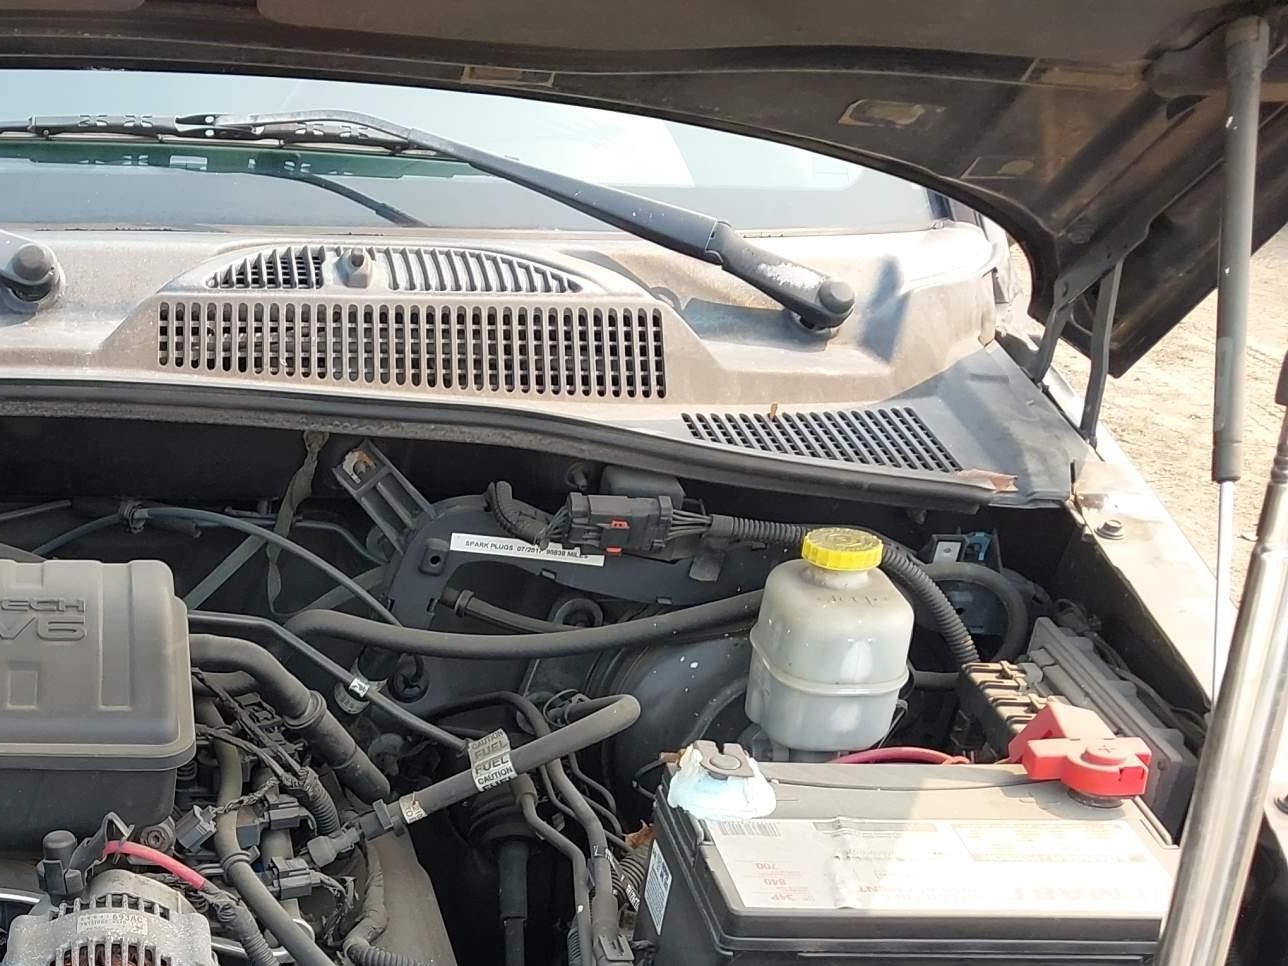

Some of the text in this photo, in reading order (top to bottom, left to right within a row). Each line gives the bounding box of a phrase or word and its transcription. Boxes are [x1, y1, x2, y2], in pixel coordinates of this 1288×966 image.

[464, 540, 489, 549] SPARK
[490, 543, 513, 551] PLUGS
[471, 730, 504, 750] CAUTION
[474, 740, 508, 761] FUEL
[475, 756, 509, 775] FUEL
[477, 767, 513, 785] CAUTION
